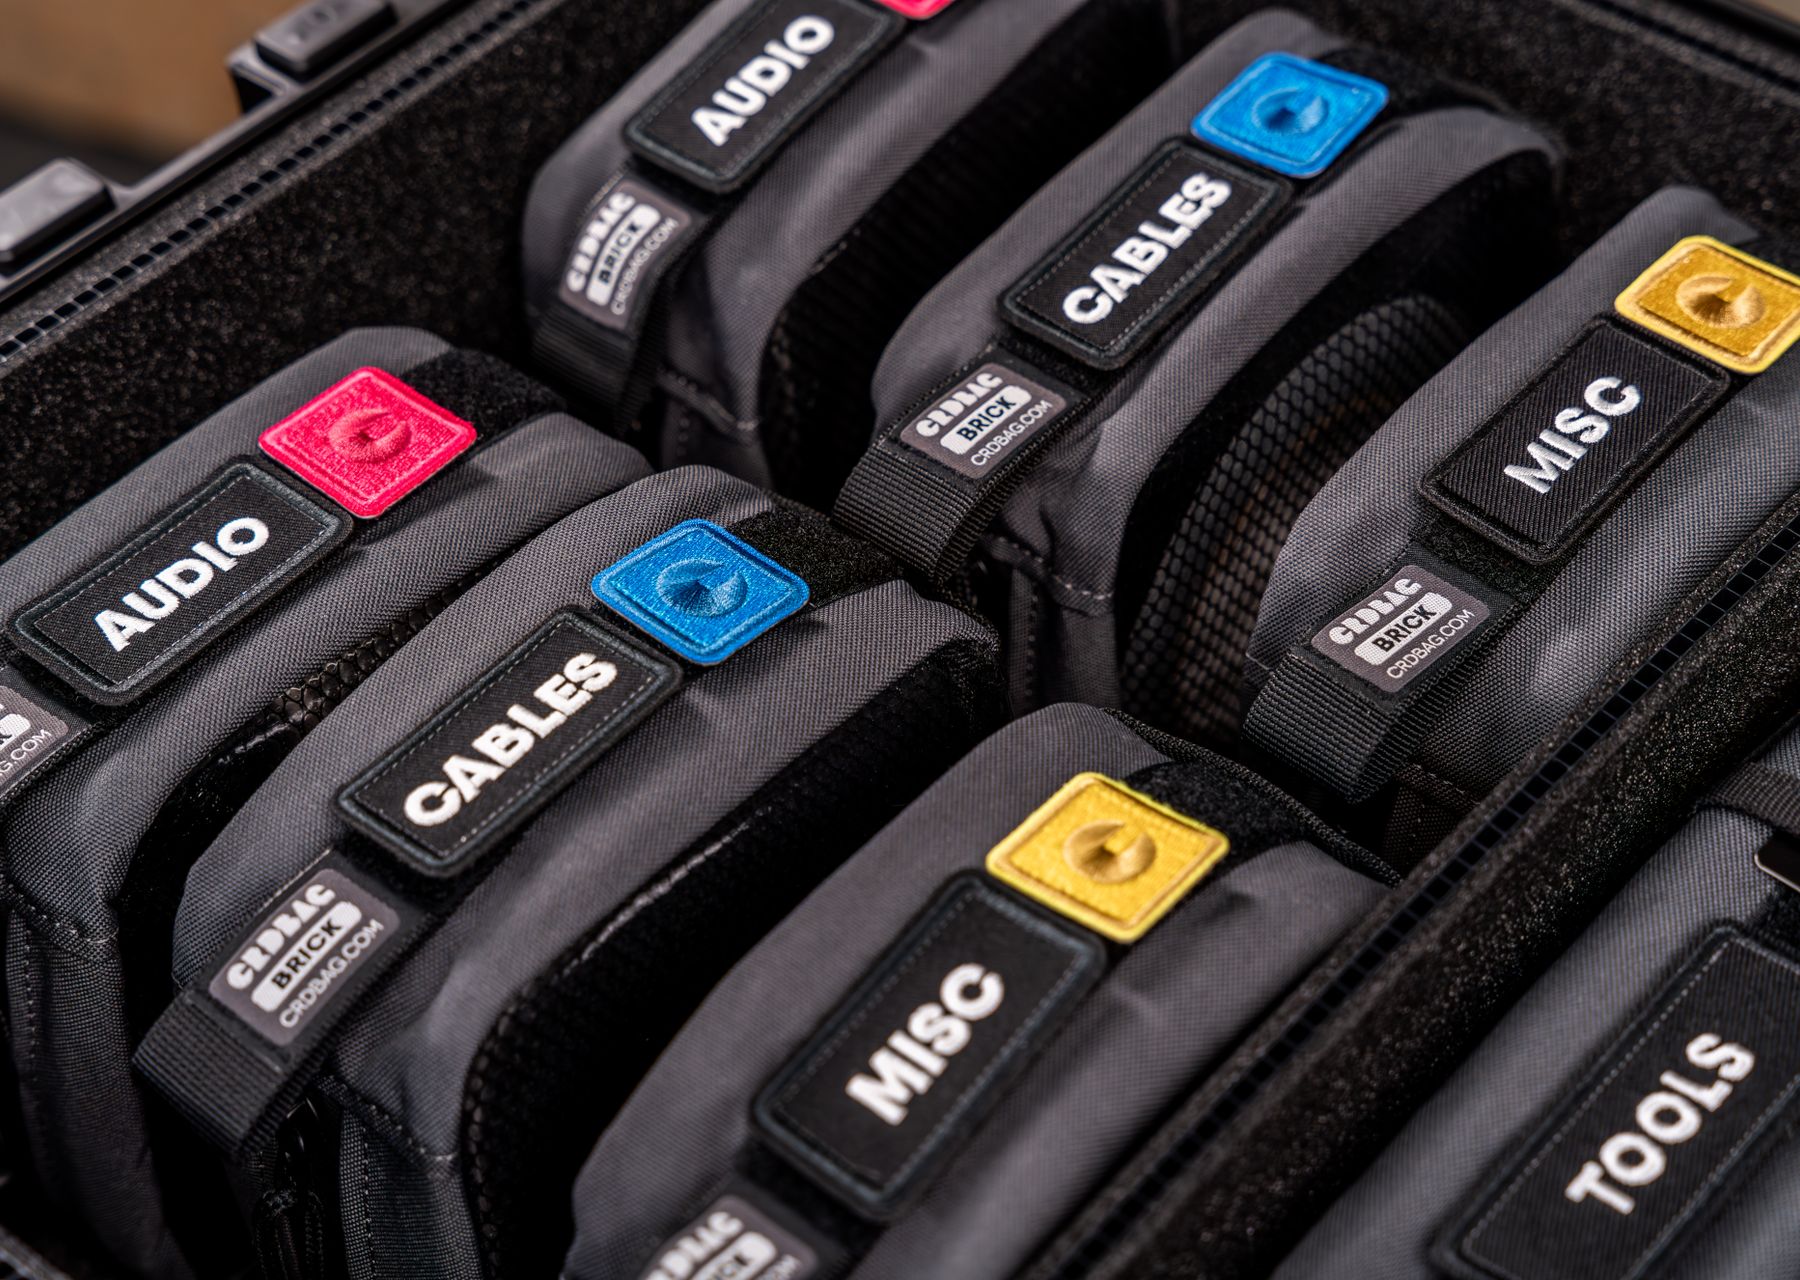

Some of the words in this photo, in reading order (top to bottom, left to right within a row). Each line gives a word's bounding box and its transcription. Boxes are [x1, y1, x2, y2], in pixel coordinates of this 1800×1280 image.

[691, 15, 835, 147] AUDIO
[598, 222, 641, 284] BRICK
[611, 217, 679, 315] CRDBAG.COM
[1062, 172, 1232, 324] CABLES
[916, 373, 1003, 437] CRDBAG
[957, 396, 1017, 441] BRICK
[971, 400, 1053, 466] CRDBAG.COM
[1503, 376, 1641, 494] MISC
[94, 517, 269, 653] AUDIO
[1329, 578, 1422, 645] CRDBAG
[1372, 603, 1437, 652] BRICK
[1386, 609, 1475, 679] CRDBAG.COM
[0, 729, 52, 775] G.COM
[404, 653, 618, 827] CABLES
[226, 884, 336, 990] CRDBAG
[272, 917, 342, 989] BRICK
[279, 918, 384, 1028] CRDBAG.COM
[845, 962, 1005, 1126] MISC
[1565, 1033, 1755, 1215] TOOLS
